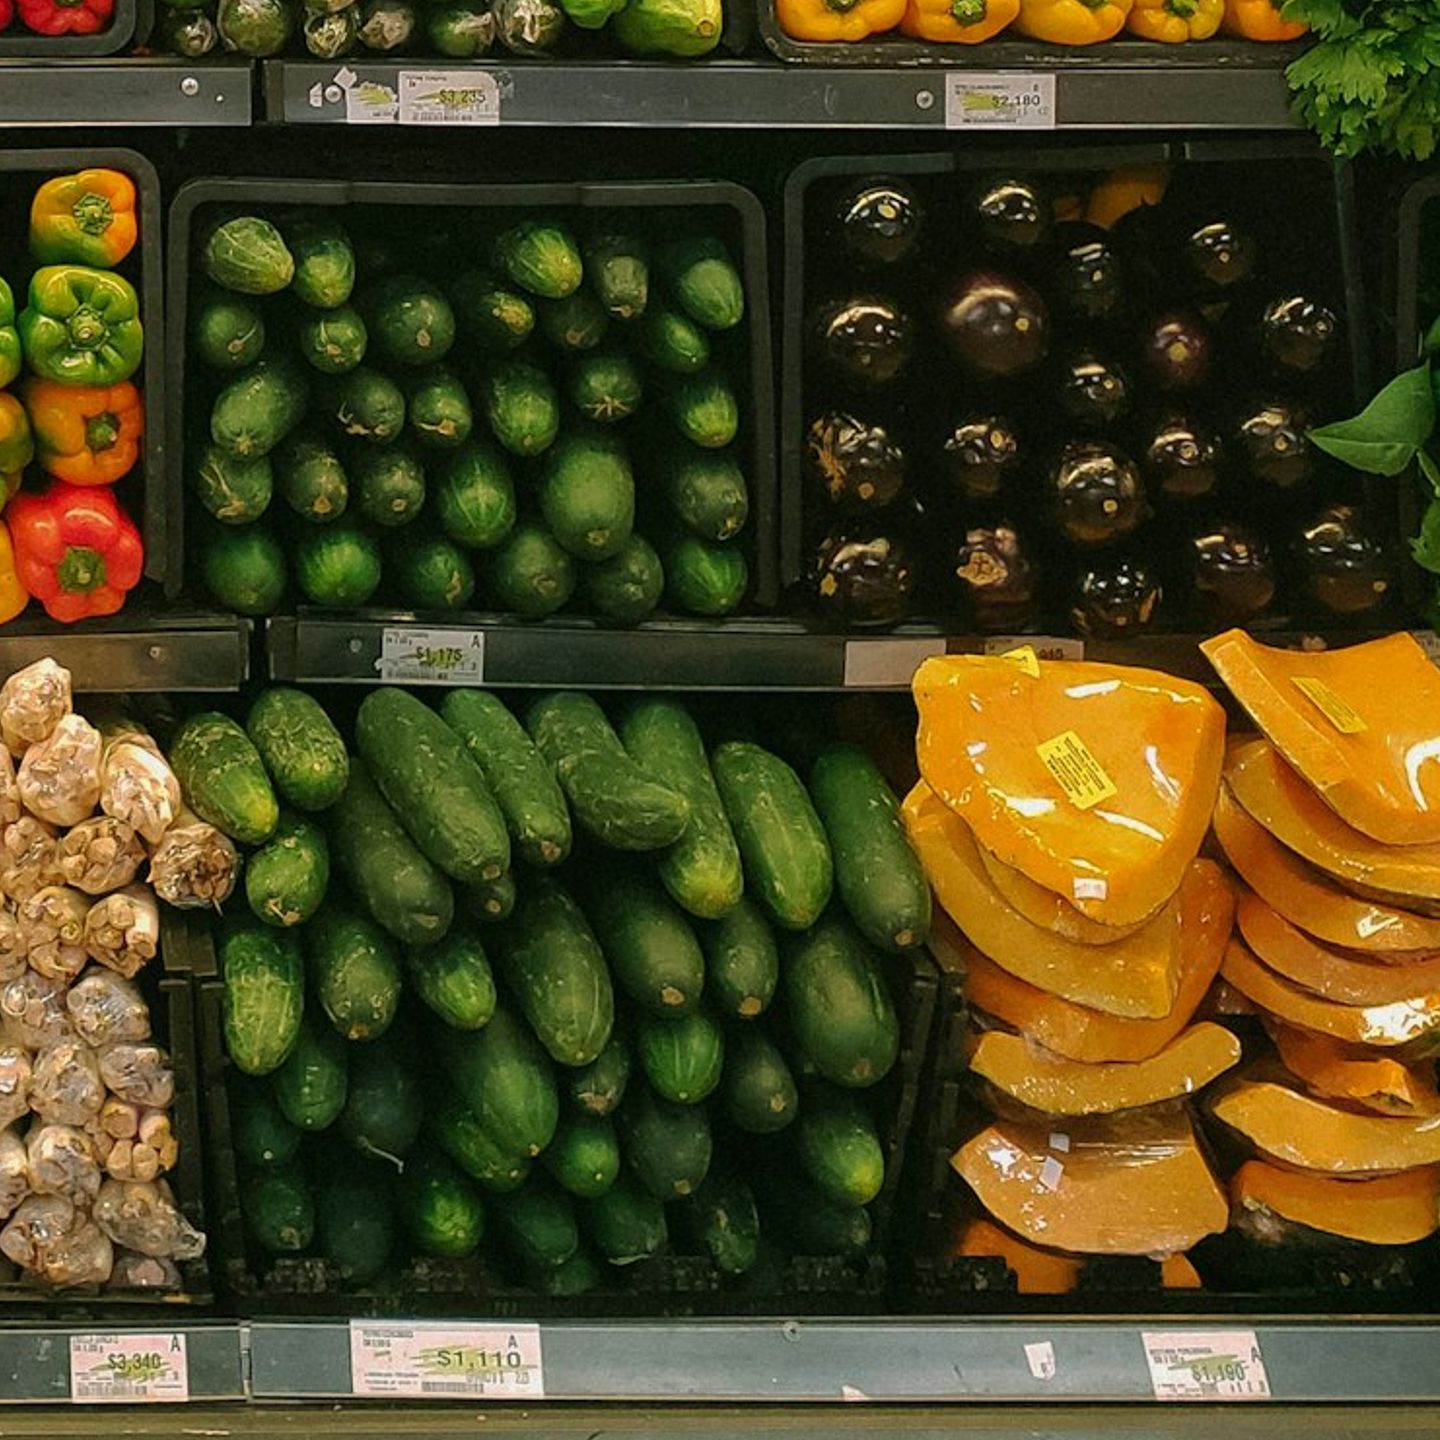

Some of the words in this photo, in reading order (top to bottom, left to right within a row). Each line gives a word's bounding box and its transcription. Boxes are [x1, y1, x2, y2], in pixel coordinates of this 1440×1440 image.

[471, 633, 481, 649] A
[171, 1334, 181, 1352] A
[507, 1334, 518, 1349] A
[107, 1352, 162, 1372] $3,340
[437, 1349, 521, 1372] $1,110
